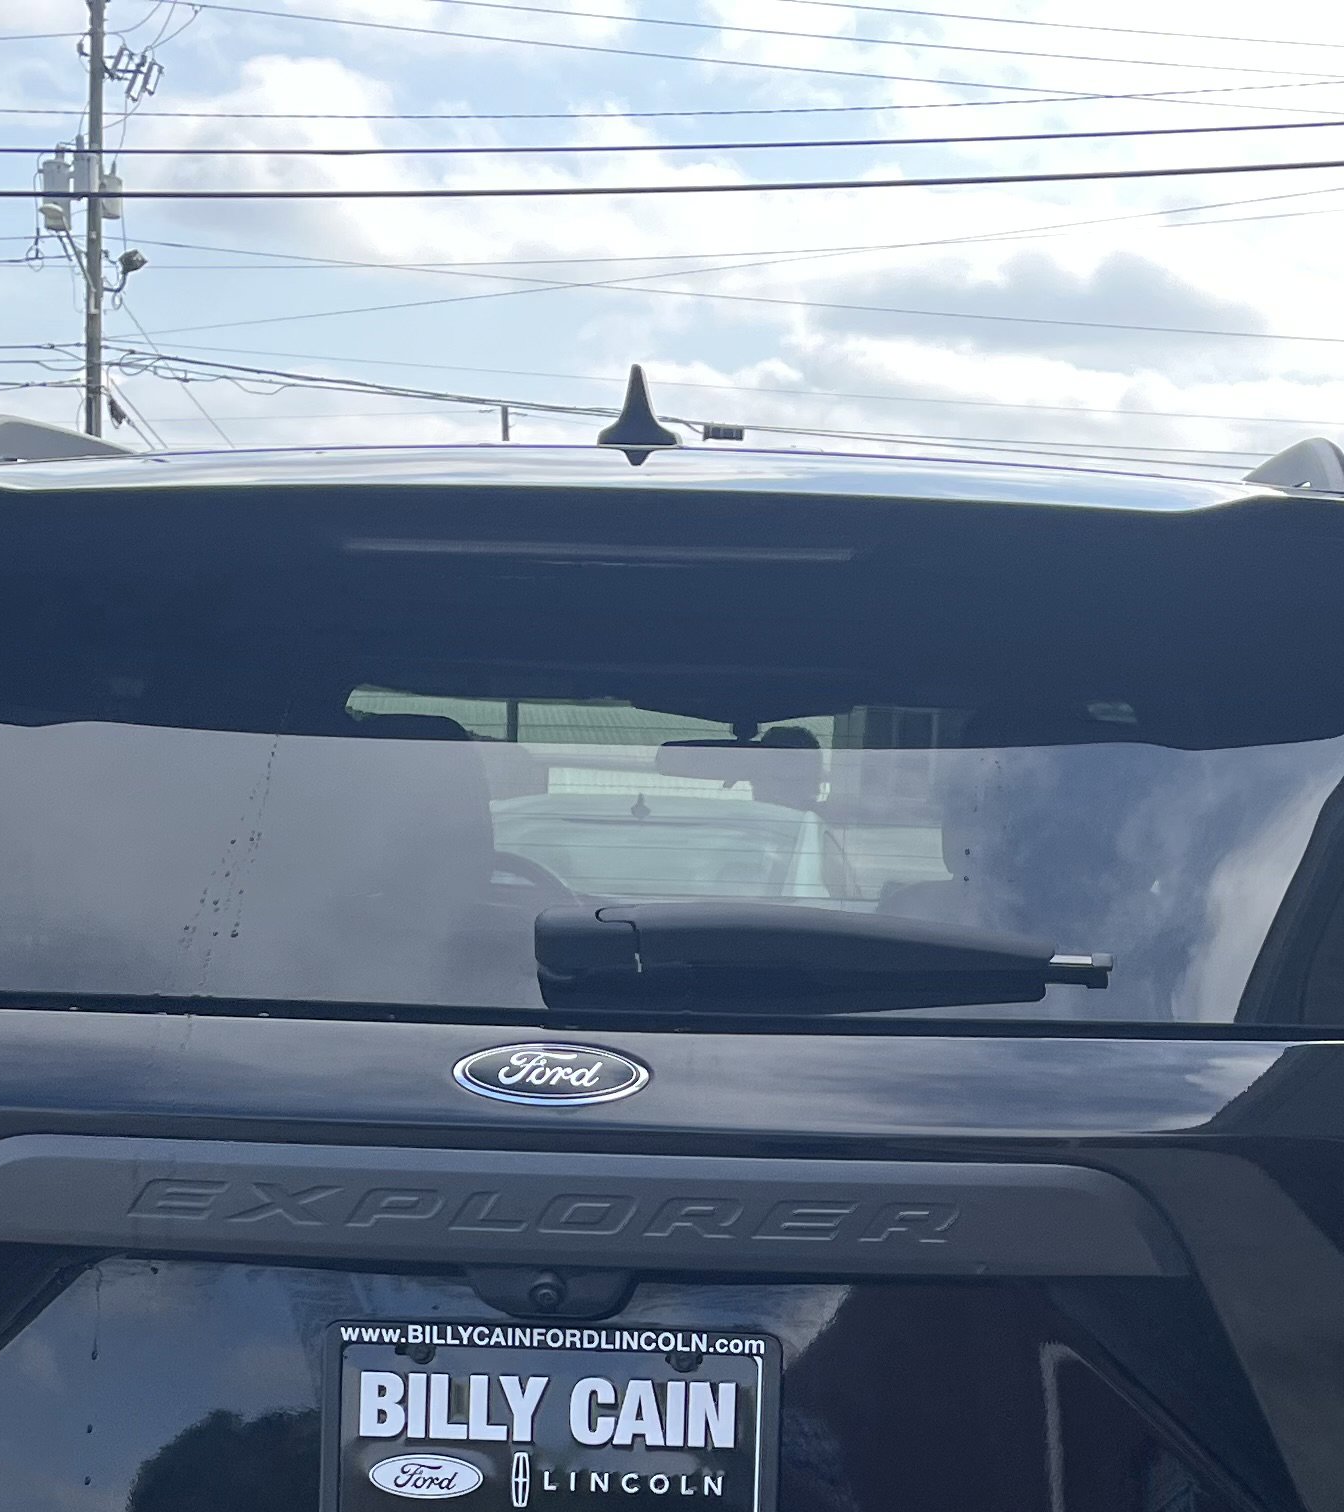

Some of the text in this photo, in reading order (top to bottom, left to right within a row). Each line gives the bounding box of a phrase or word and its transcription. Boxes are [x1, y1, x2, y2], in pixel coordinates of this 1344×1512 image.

[497, 1051, 603, 1088] Ford
[125, 1177, 964, 1247] EXPLORER
[340, 1324, 765, 1355] www.BILLYCAINFORDLINCOLN.com
[359, 1370, 737, 1449] BILLY CAIN
[393, 1462, 458, 1492] Ford
[543, 1470, 724, 1498] LINCOLN
